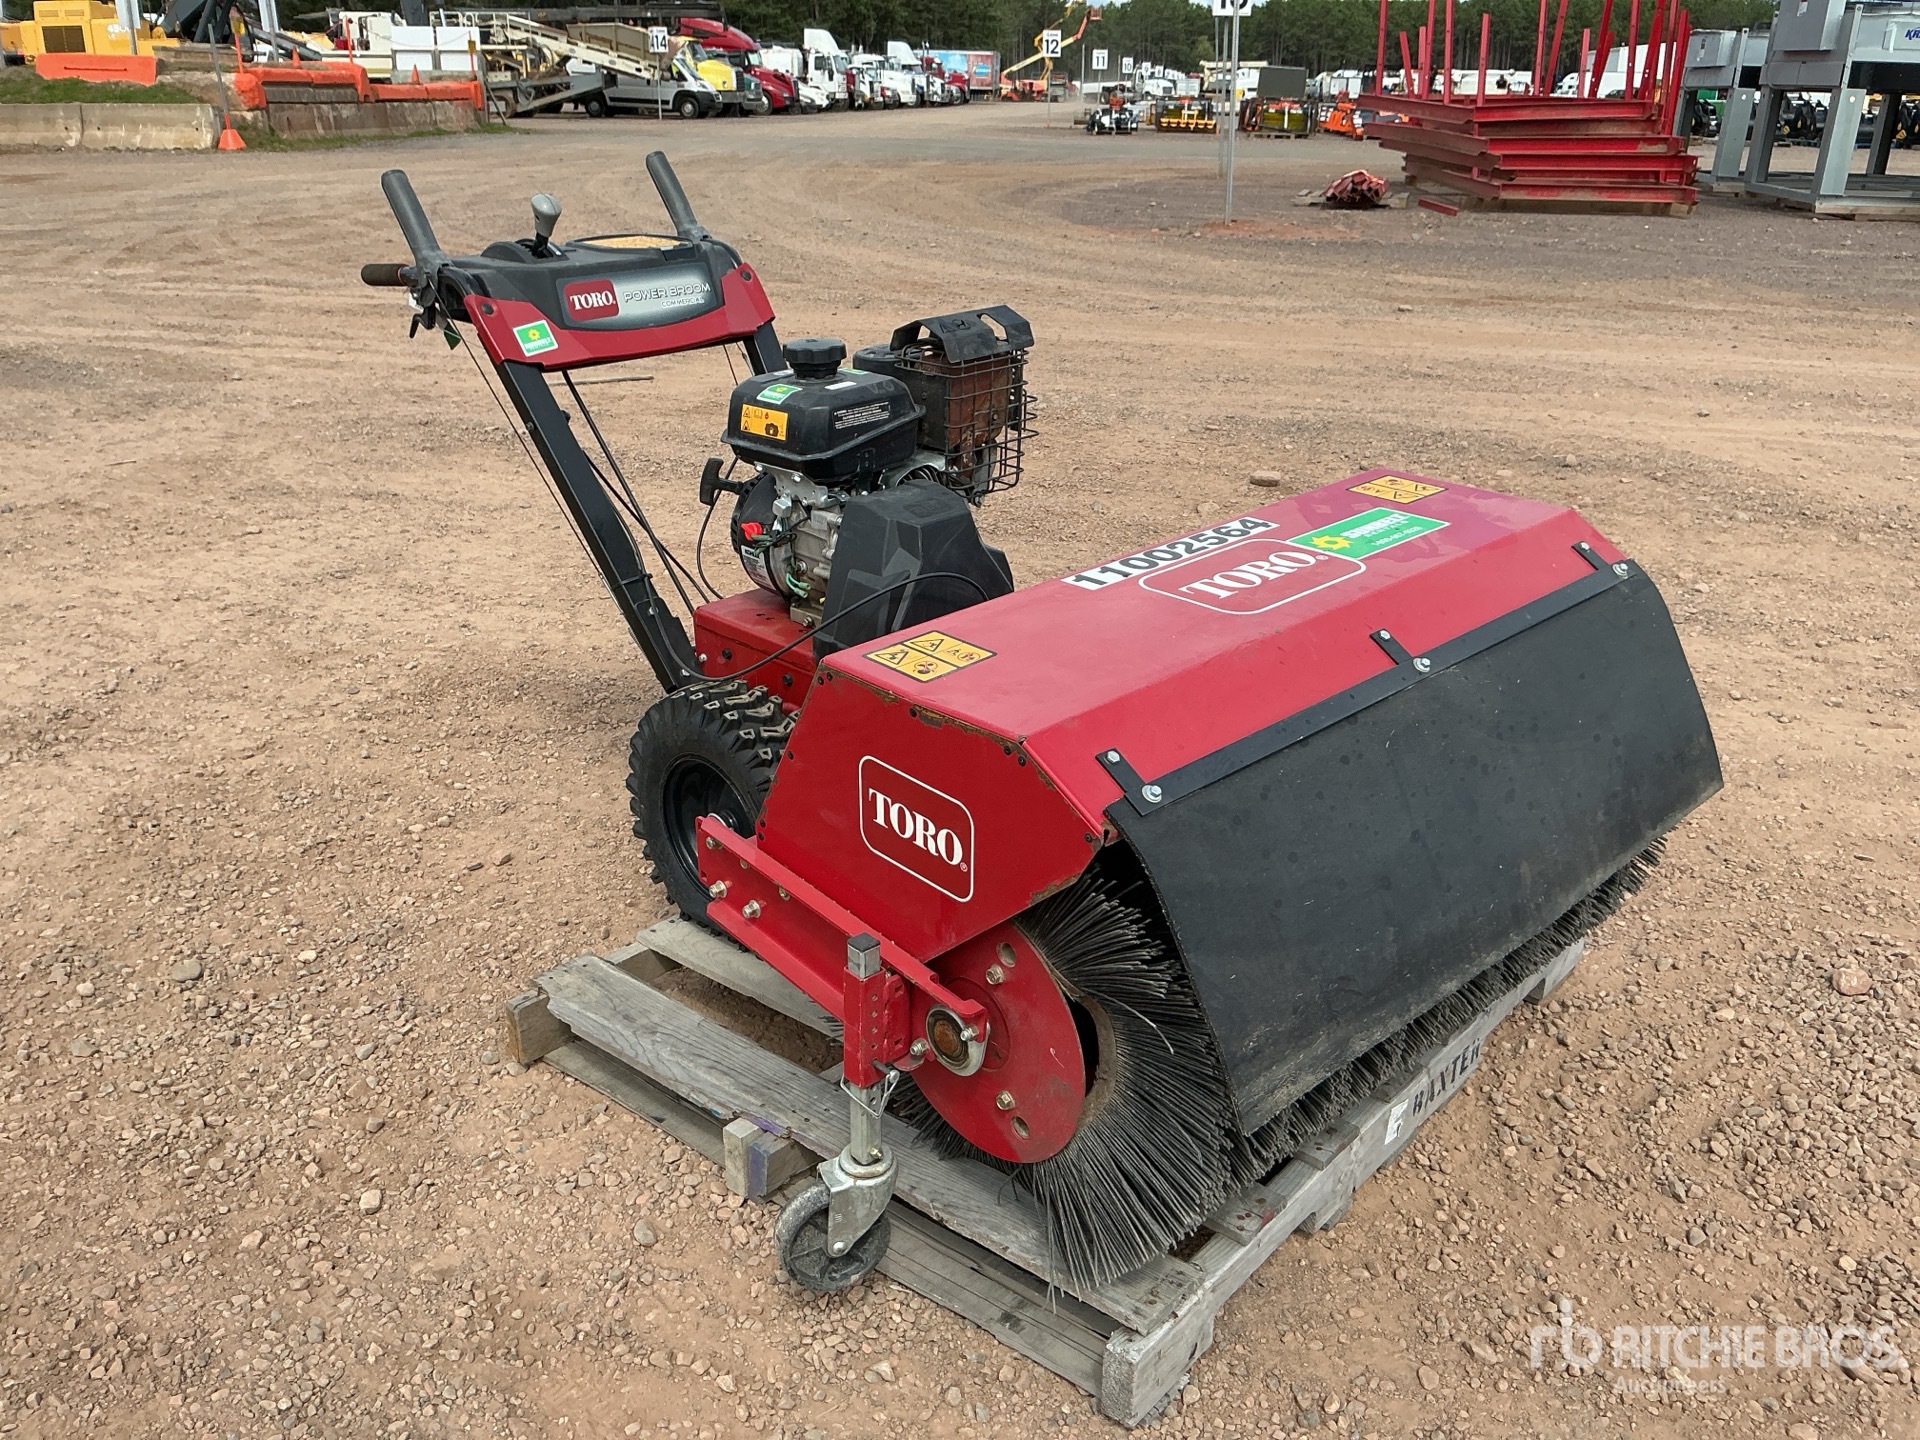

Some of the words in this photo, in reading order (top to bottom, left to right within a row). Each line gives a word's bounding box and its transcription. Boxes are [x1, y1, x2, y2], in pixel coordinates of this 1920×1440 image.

[654, 34, 667, 50] 14
[1044, 38, 1059, 55] 12
[1095, 55, 1105, 68] 11
[1123, 62, 1132, 72] 10
[569, 290, 613, 311] TORO
[623, 288, 668, 303] POWER
[669, 283, 711, 297] BROOM
[661, 296, 705, 308] COMMERCIAL
[1072, 518, 1273, 586] 11002564
[1178, 551, 1317, 599] TORO
[868, 788, 964, 867] TORO
